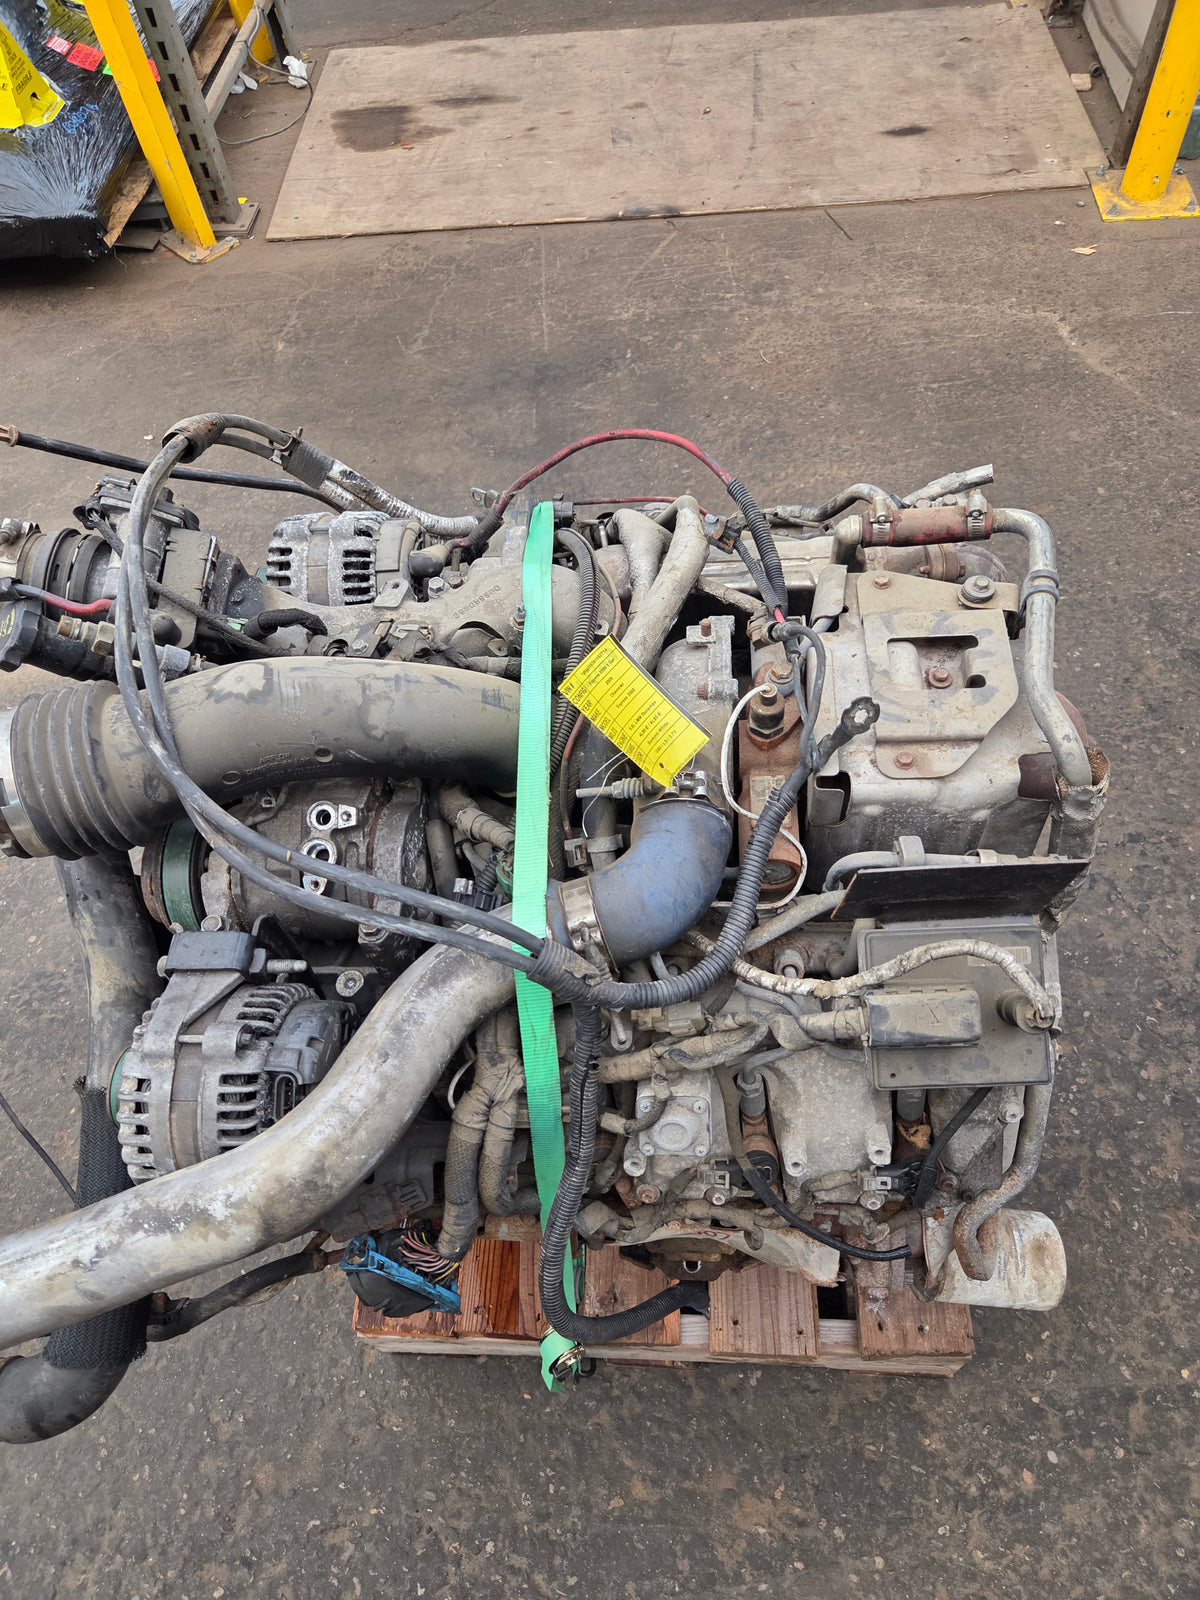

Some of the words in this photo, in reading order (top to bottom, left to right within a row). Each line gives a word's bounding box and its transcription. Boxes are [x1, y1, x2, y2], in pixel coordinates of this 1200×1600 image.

[16, 70, 33, 93] FRAGILE
[562, 685, 573, 696] VIN
[572, 687, 588, 704] CONFIG
[609, 683, 624, 698] Chevrolet
[581, 699, 593, 713] YEAR
[616, 696, 628, 709] Express
[590, 709, 602, 721] MAKE
[599, 716, 611, 730] MODEL
